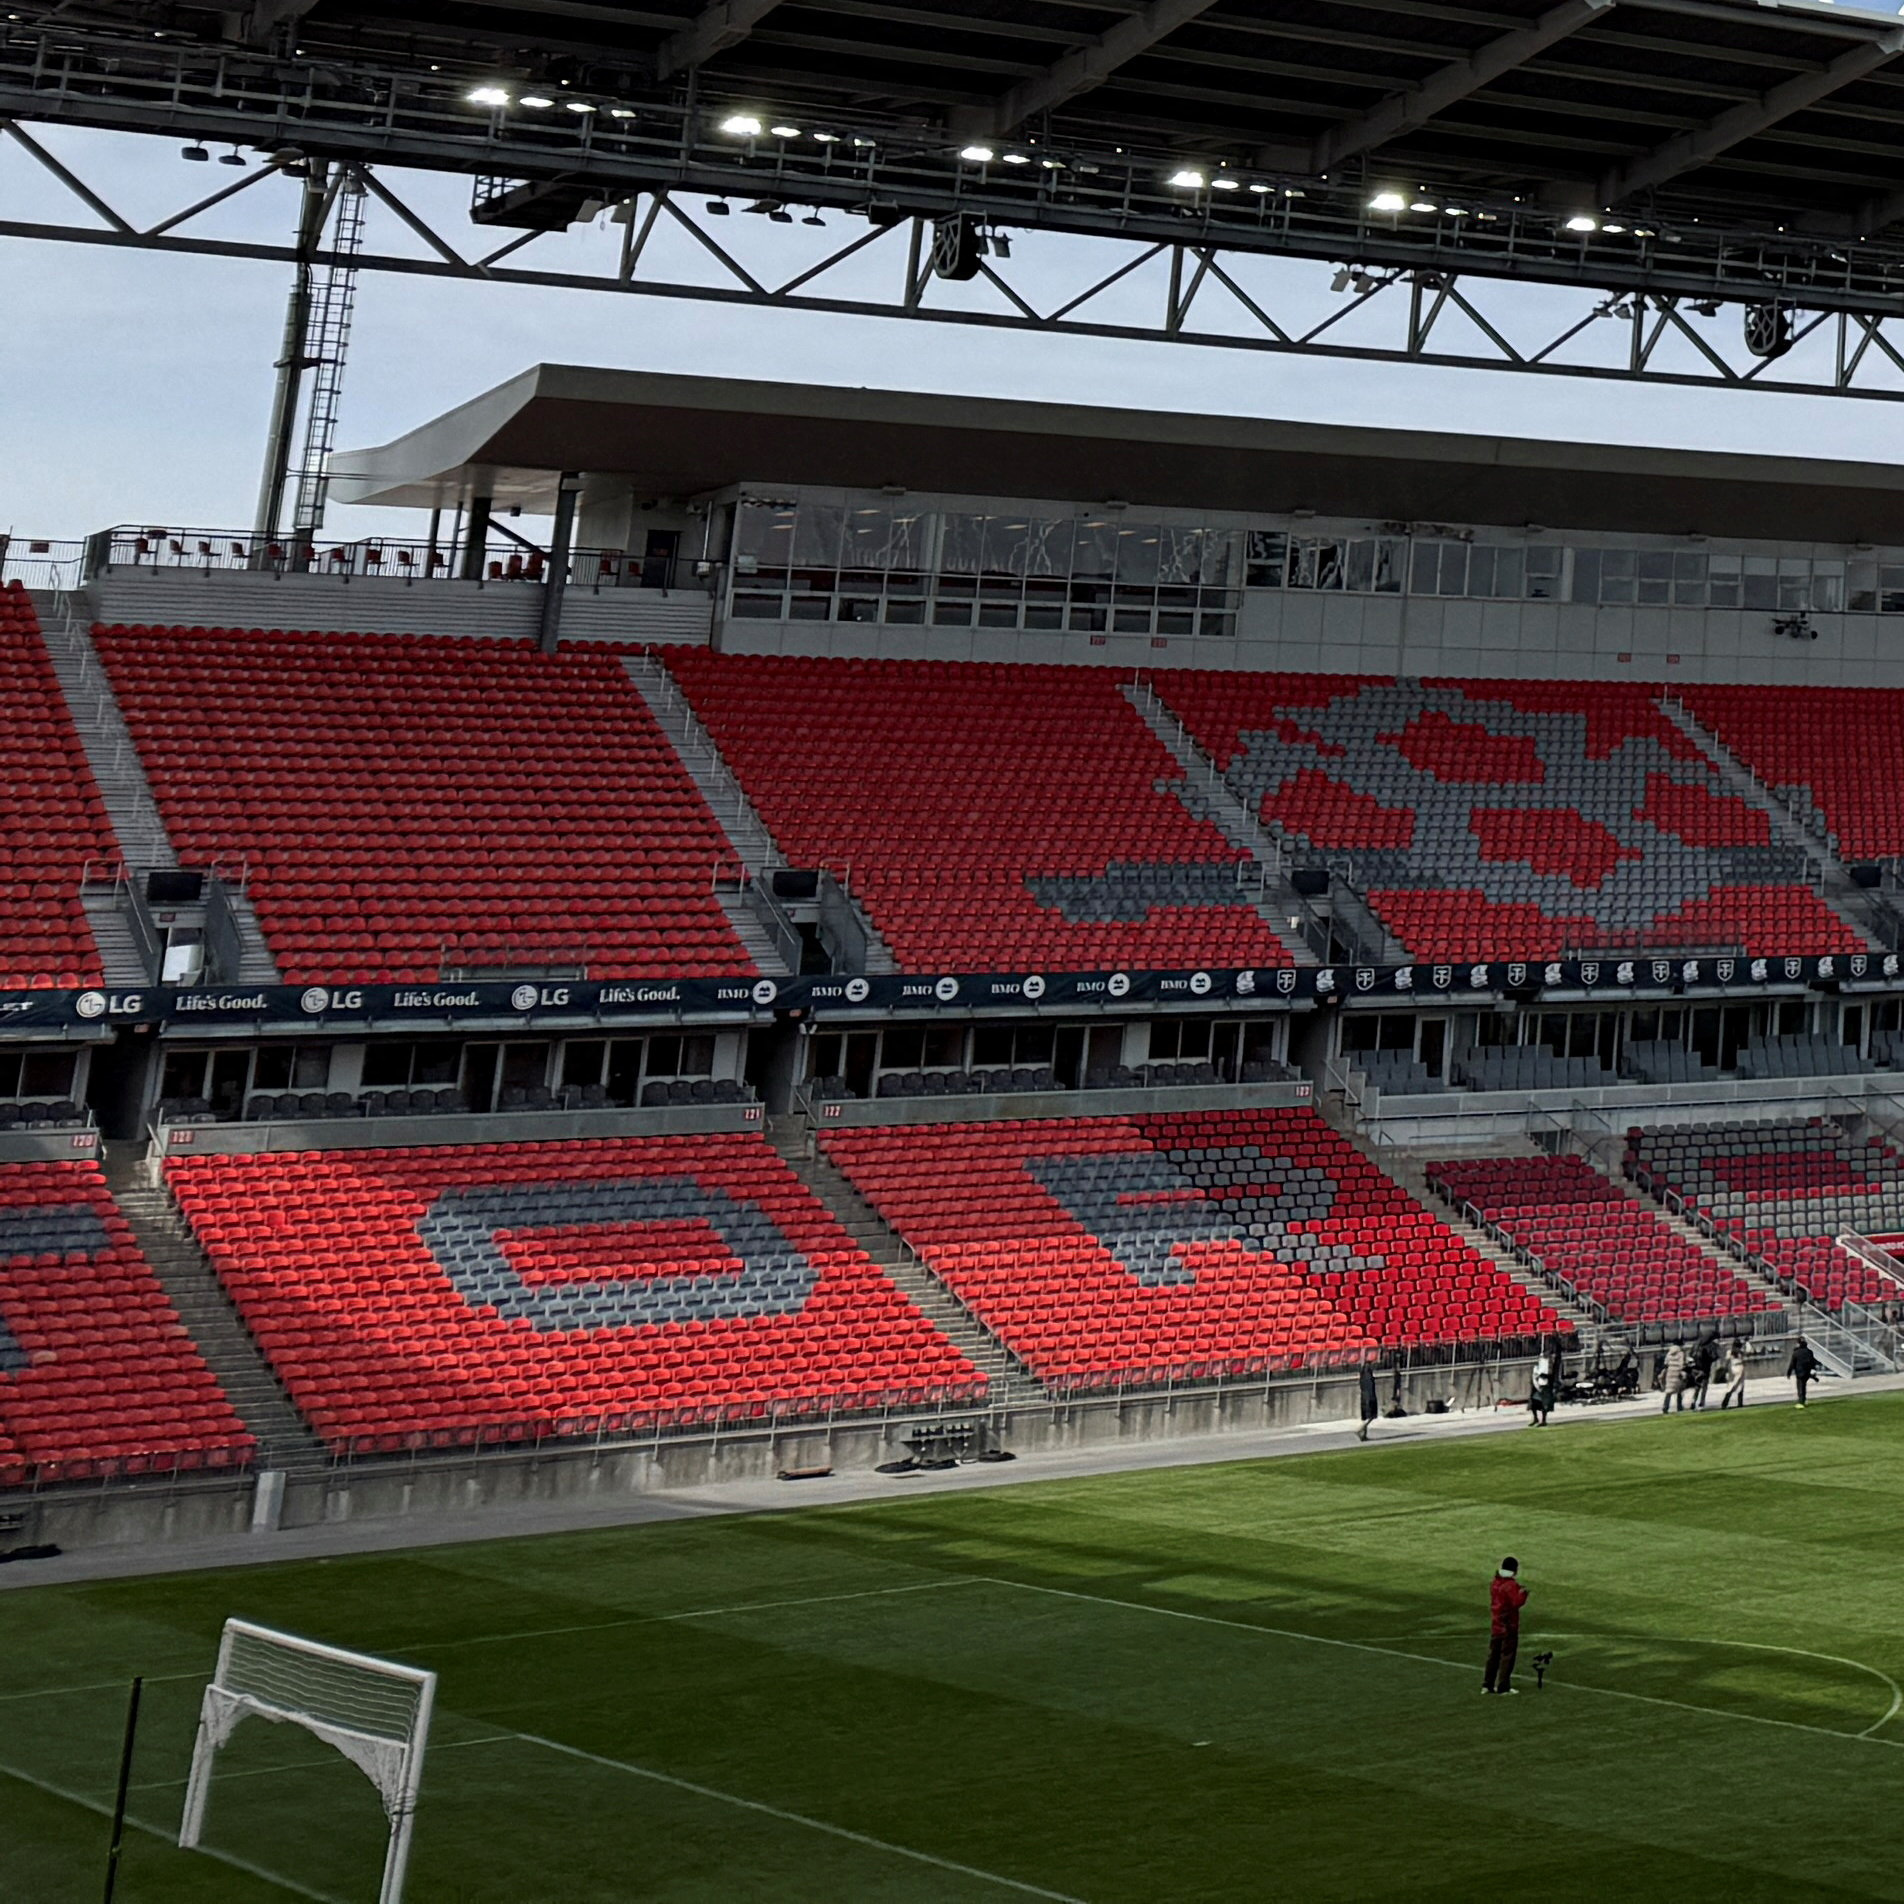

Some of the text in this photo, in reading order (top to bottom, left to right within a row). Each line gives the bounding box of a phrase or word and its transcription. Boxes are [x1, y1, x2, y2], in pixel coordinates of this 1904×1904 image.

[903, 986, 932, 995] BMO
[992, 984, 1020, 993] BMO
[1077, 982, 1105, 991] BMO
[1161, 981, 1187, 989] BMO
[541, 989, 569, 1005] LG
[600, 987, 680, 1002] Life's Good.
[718, 989, 749, 998] BMO
[812, 987, 842, 996] BMO
[109, 995, 141, 1013] LG
[176, 994, 267, 1010] Life's Good.
[332, 991, 362, 1008] LG
[394, 992, 479, 1006] Life's Good.
